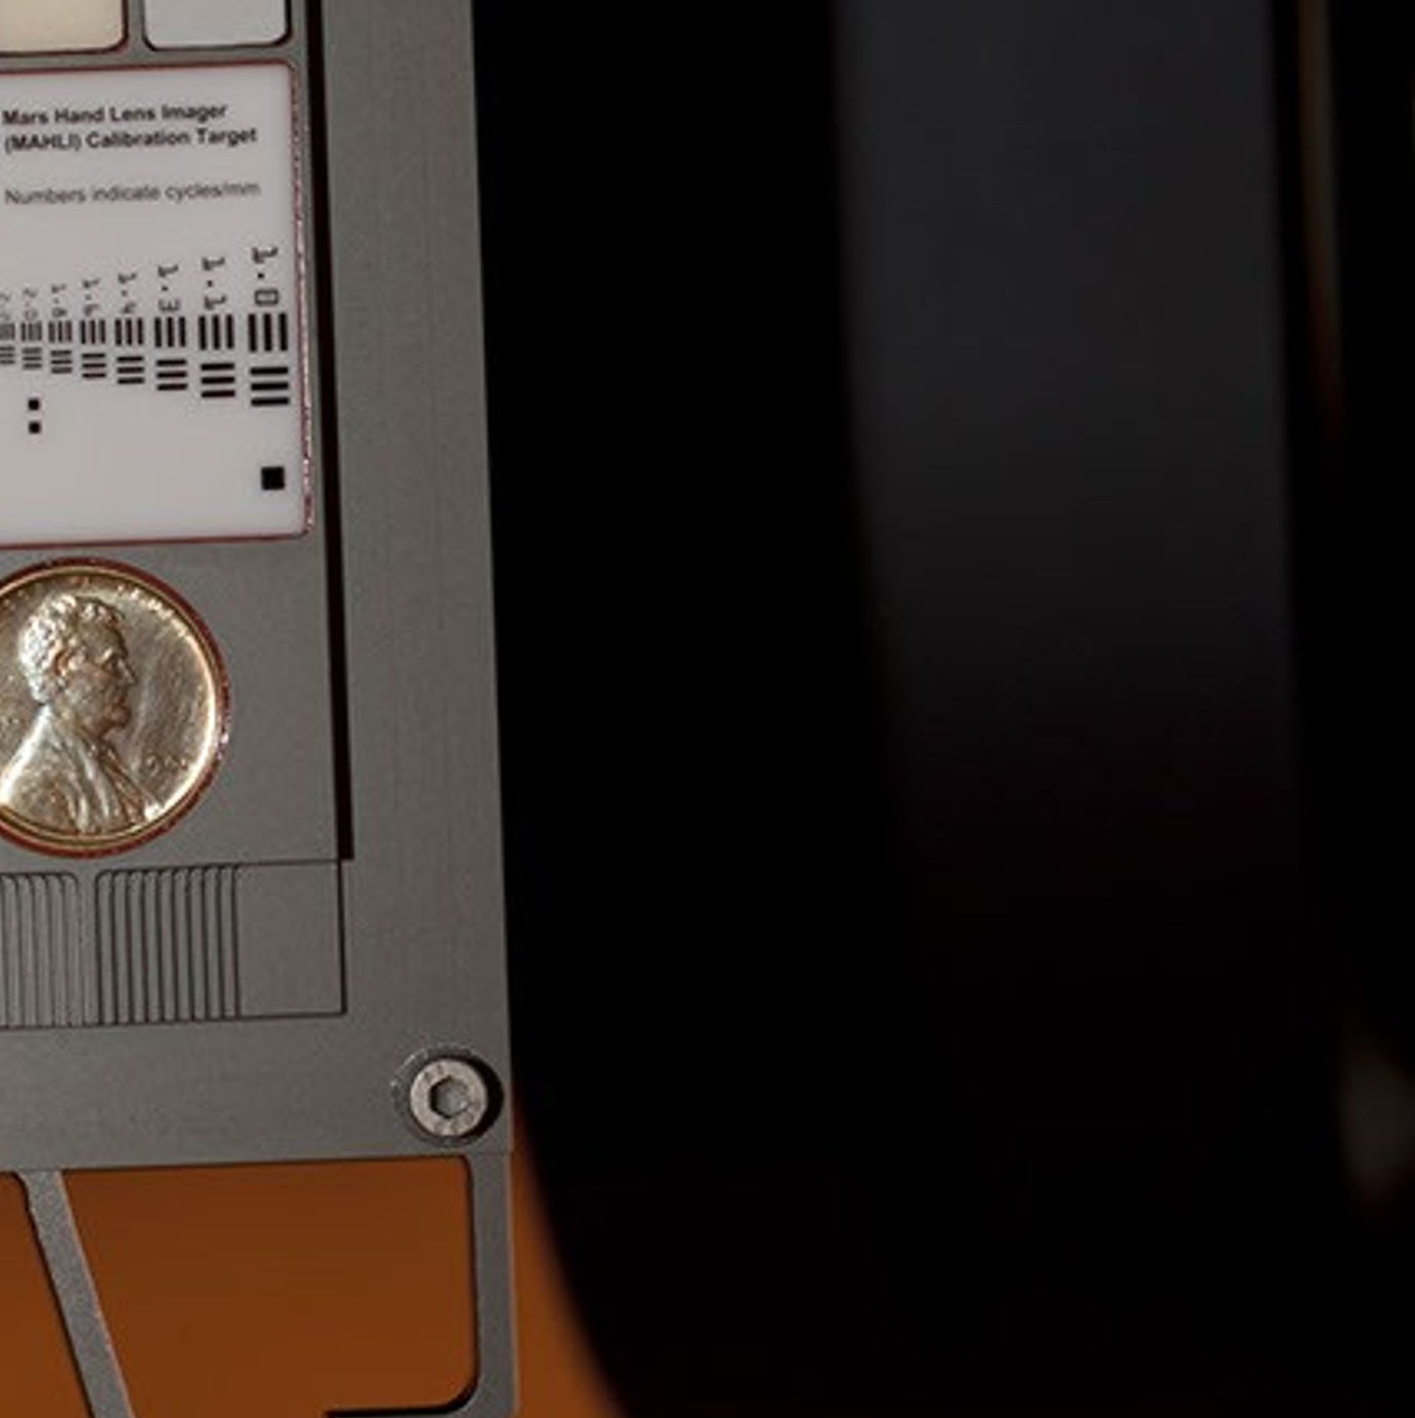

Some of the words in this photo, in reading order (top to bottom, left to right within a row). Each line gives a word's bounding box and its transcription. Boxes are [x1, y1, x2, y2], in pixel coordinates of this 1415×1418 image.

[2, 110, 49, 126] Mars
[55, 107, 105, 124] Hand
[110, 106, 156, 122] Lens
[162, 104, 227, 122] Imager
[4, 133, 82, 154] (MAHLI)
[86, 128, 190, 150] Calibration
[196, 127, 257, 147] Target
[4, 187, 85, 205] Numbers
[92, 184, 160, 203] indicate
[165, 182, 261, 203] cycles/mm
[157, 264, 180, 312] 1.3
[201, 256, 227, 311] 1.1
[251, 246, 279, 306] 1.0
